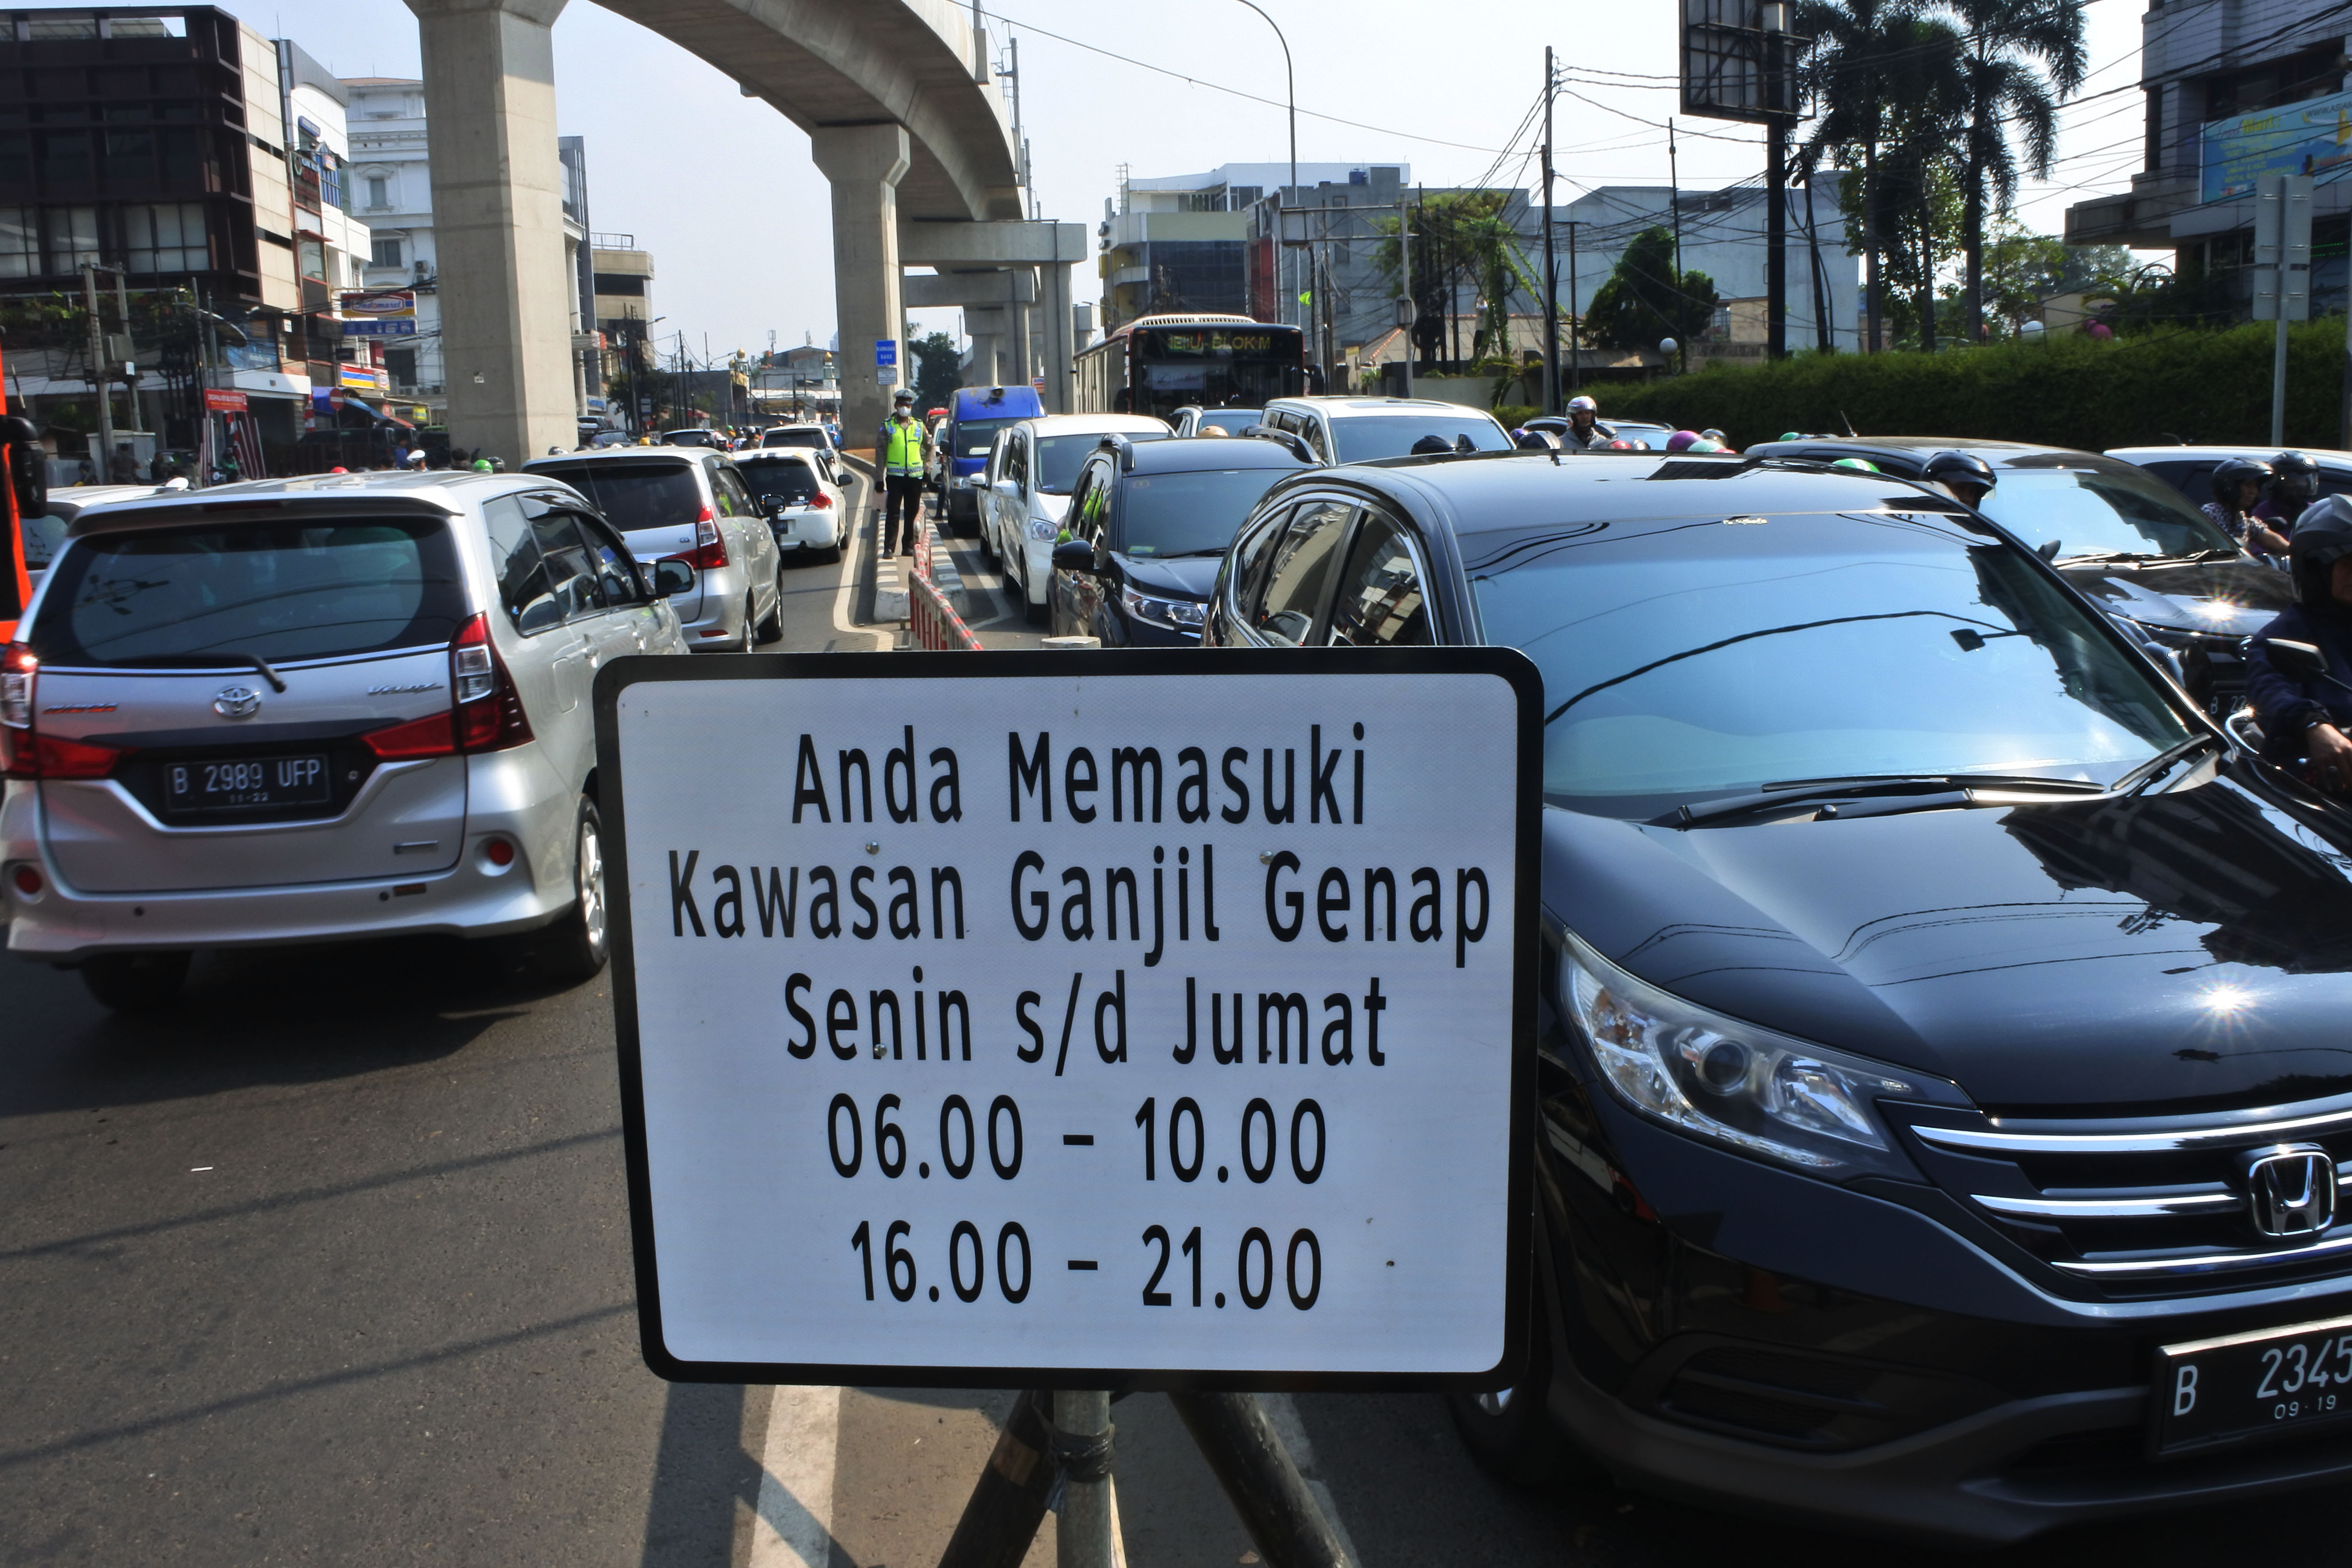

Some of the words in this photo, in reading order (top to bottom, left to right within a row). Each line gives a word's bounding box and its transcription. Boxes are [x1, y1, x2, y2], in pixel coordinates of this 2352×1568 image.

[173, 767, 188, 794] B
[204, 762, 264, 792] 2989
[277, 758, 321, 788] UFP
[792, 725, 963, 824] Anda
[1008, 722, 1364, 825] Memasuki
[668, 850, 965, 940] Kawasan
[1010, 844, 1220, 967] Ganjil
[1265, 850, 1490, 969] Genap
[784, 965, 972, 1061] Senin
[1016, 969, 1127, 1077] s/d
[1172, 977, 1387, 1067] Jumat
[827, 1093, 1023, 1180] 06.00
[1135, 1097, 1326, 1184] 10.00
[851, 1220, 1031, 1304] 16.00
[1142, 1225, 1322, 1311] 21.00
[2174, 1365, 2198, 1417] B
[2256, 1335, 2352, 1398] 2345
